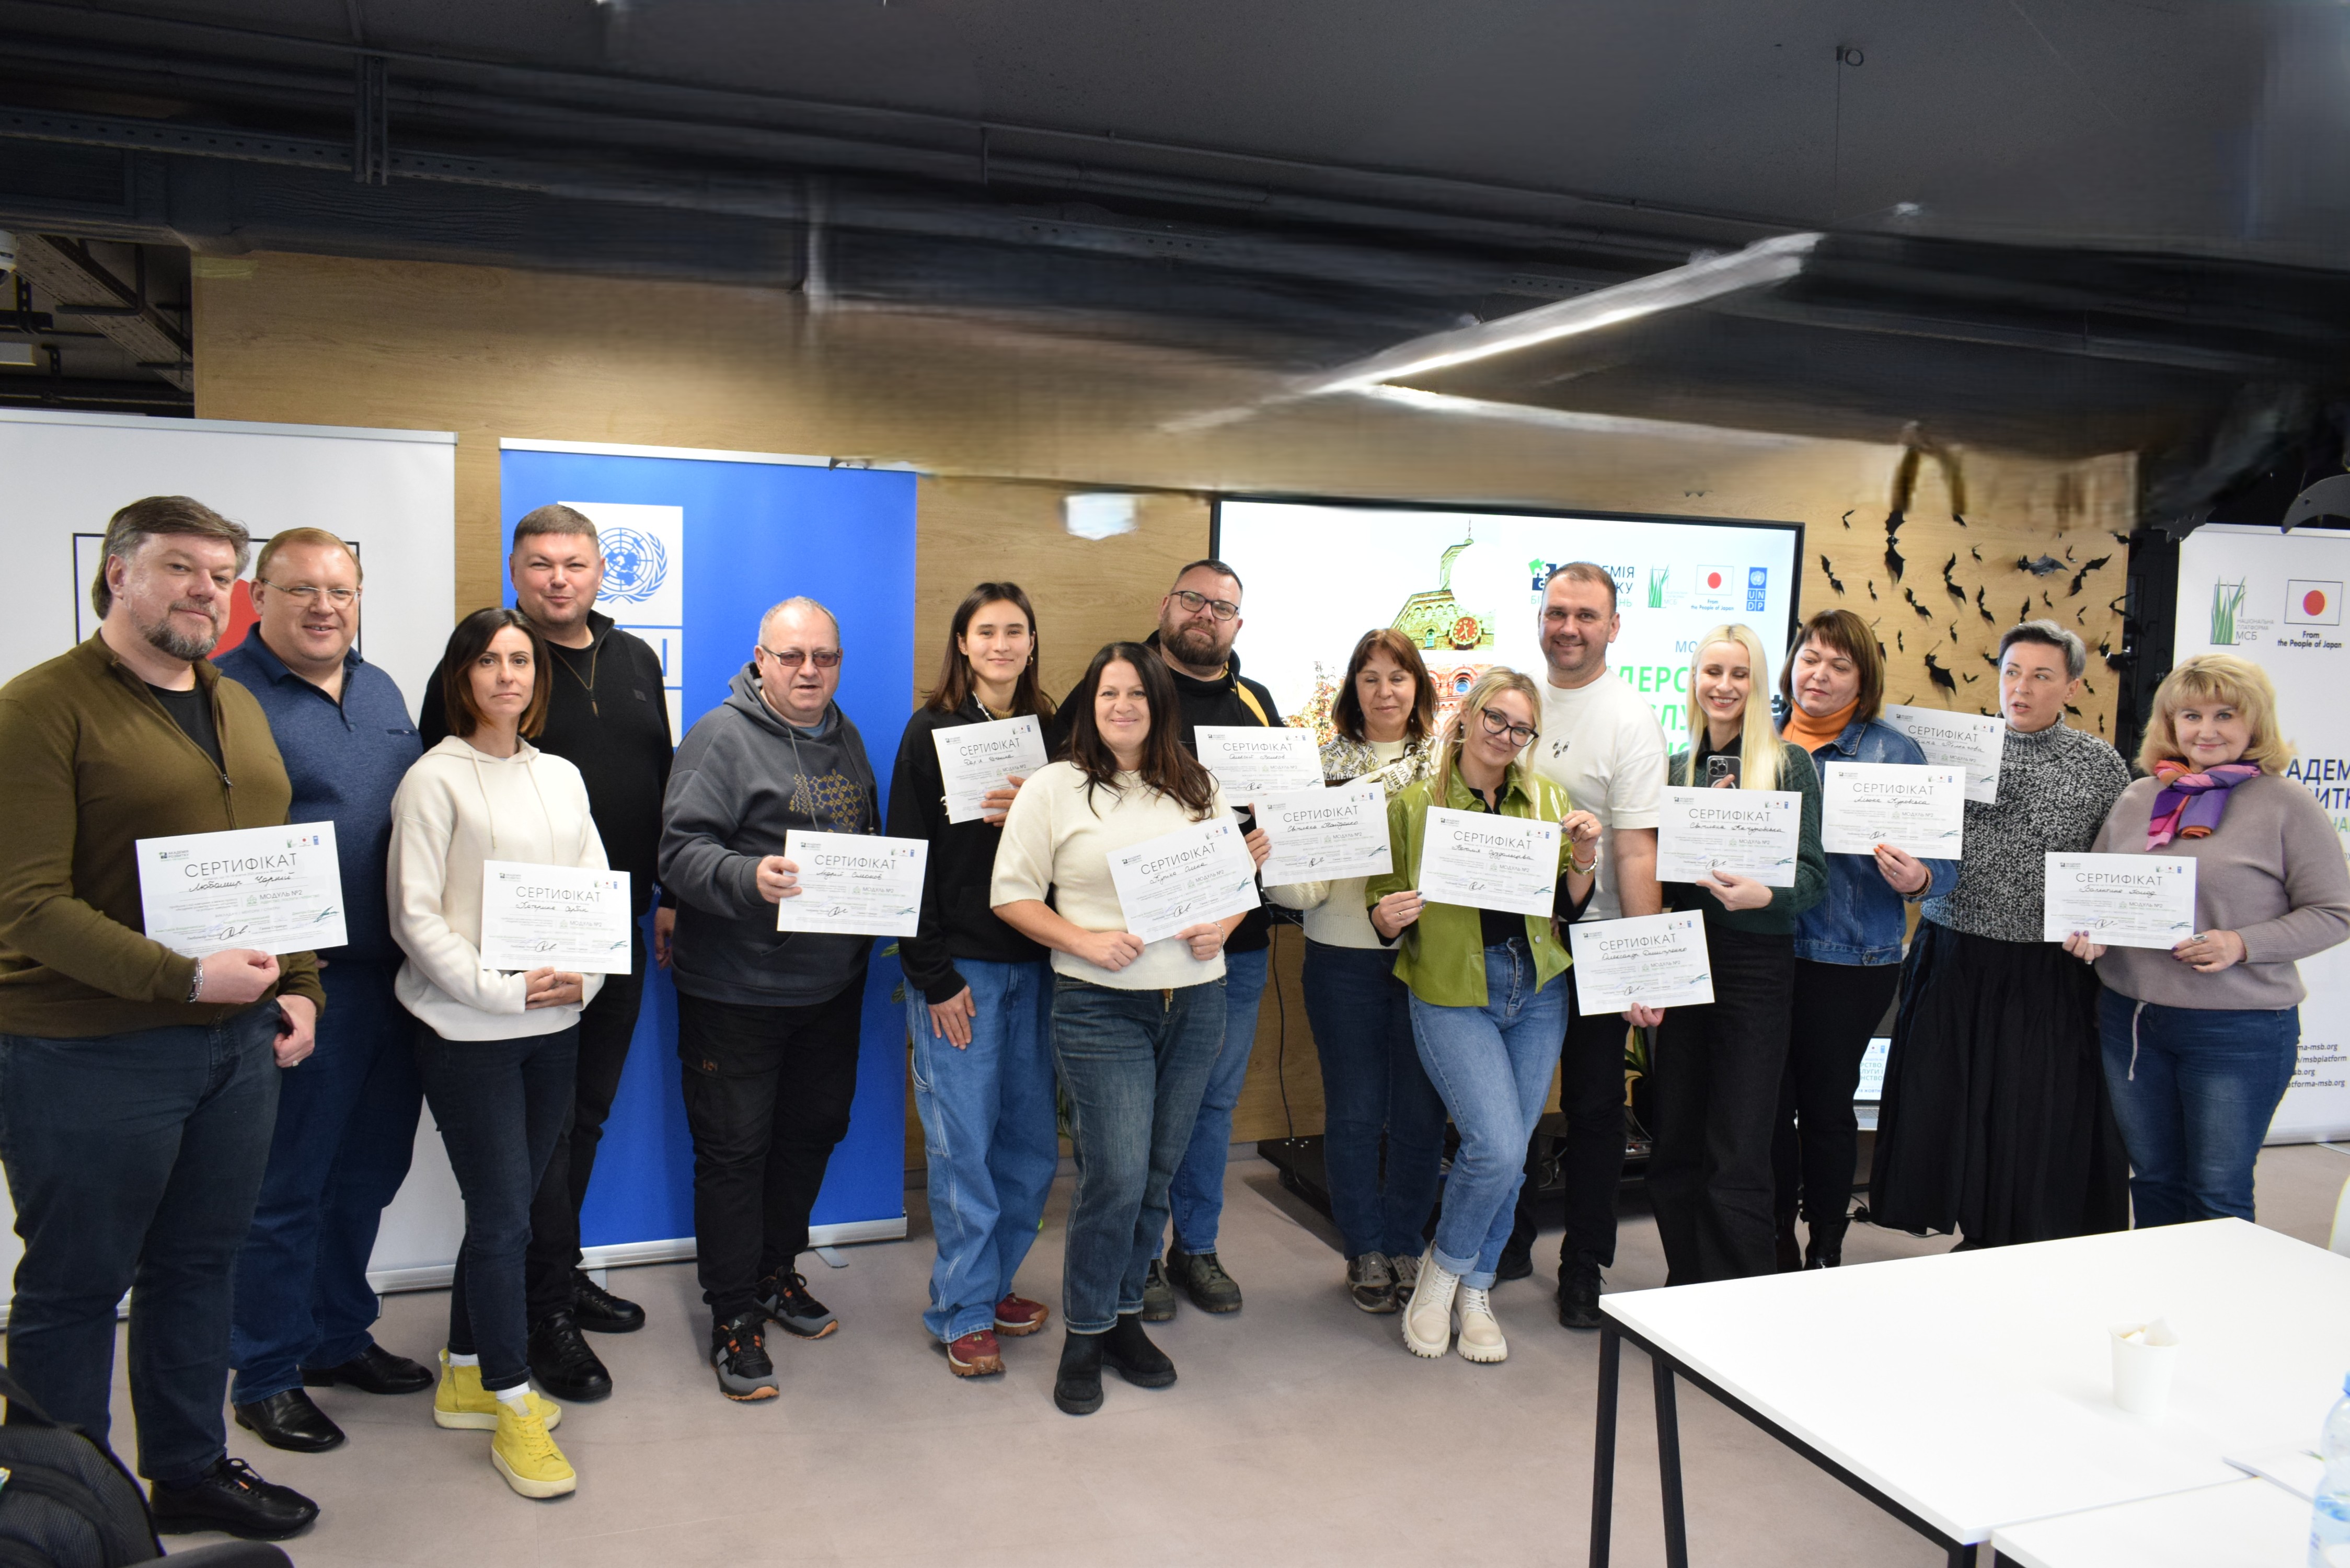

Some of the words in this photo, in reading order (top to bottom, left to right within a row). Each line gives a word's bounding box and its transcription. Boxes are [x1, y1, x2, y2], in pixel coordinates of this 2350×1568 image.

[2236, 631, 2257, 641] МСБ
[2302, 630, 2320, 639] From
[2289, 639, 2312, 649] People
[2314, 639, 2322, 648] of
[2322, 640, 2342, 650] Japan
[1908, 724, 1978, 741] СЕРТИФІКАТ
[960, 737, 1020, 756] СЕРТИФІКАТ
[1223, 742, 1293, 751] СЕРТИФІКАТ
[1852, 782, 1934, 794] СЕРТИФІКАТ
[1283, 805, 1358, 822] СЕРТИФІКАТ
[1689, 808, 1771, 821] СЕРТИФІКАТ
[1454, 831, 1532, 849] СЕРТИФІКАТ
[185, 853, 296, 877] СЕРТИФІКАТ
[814, 855, 896, 869] СЕРТИФІКАТ
[1141, 843, 1215, 874] СЕРТИФІКАТ
[189, 880, 241, 892] Любомир
[2076, 873, 2162, 885] СЕРТИФІКАТ
[516, 886, 601, 901] СЕРТИФІКАТ
[1599, 933, 1676, 950] СЕРТИФІКАТ
